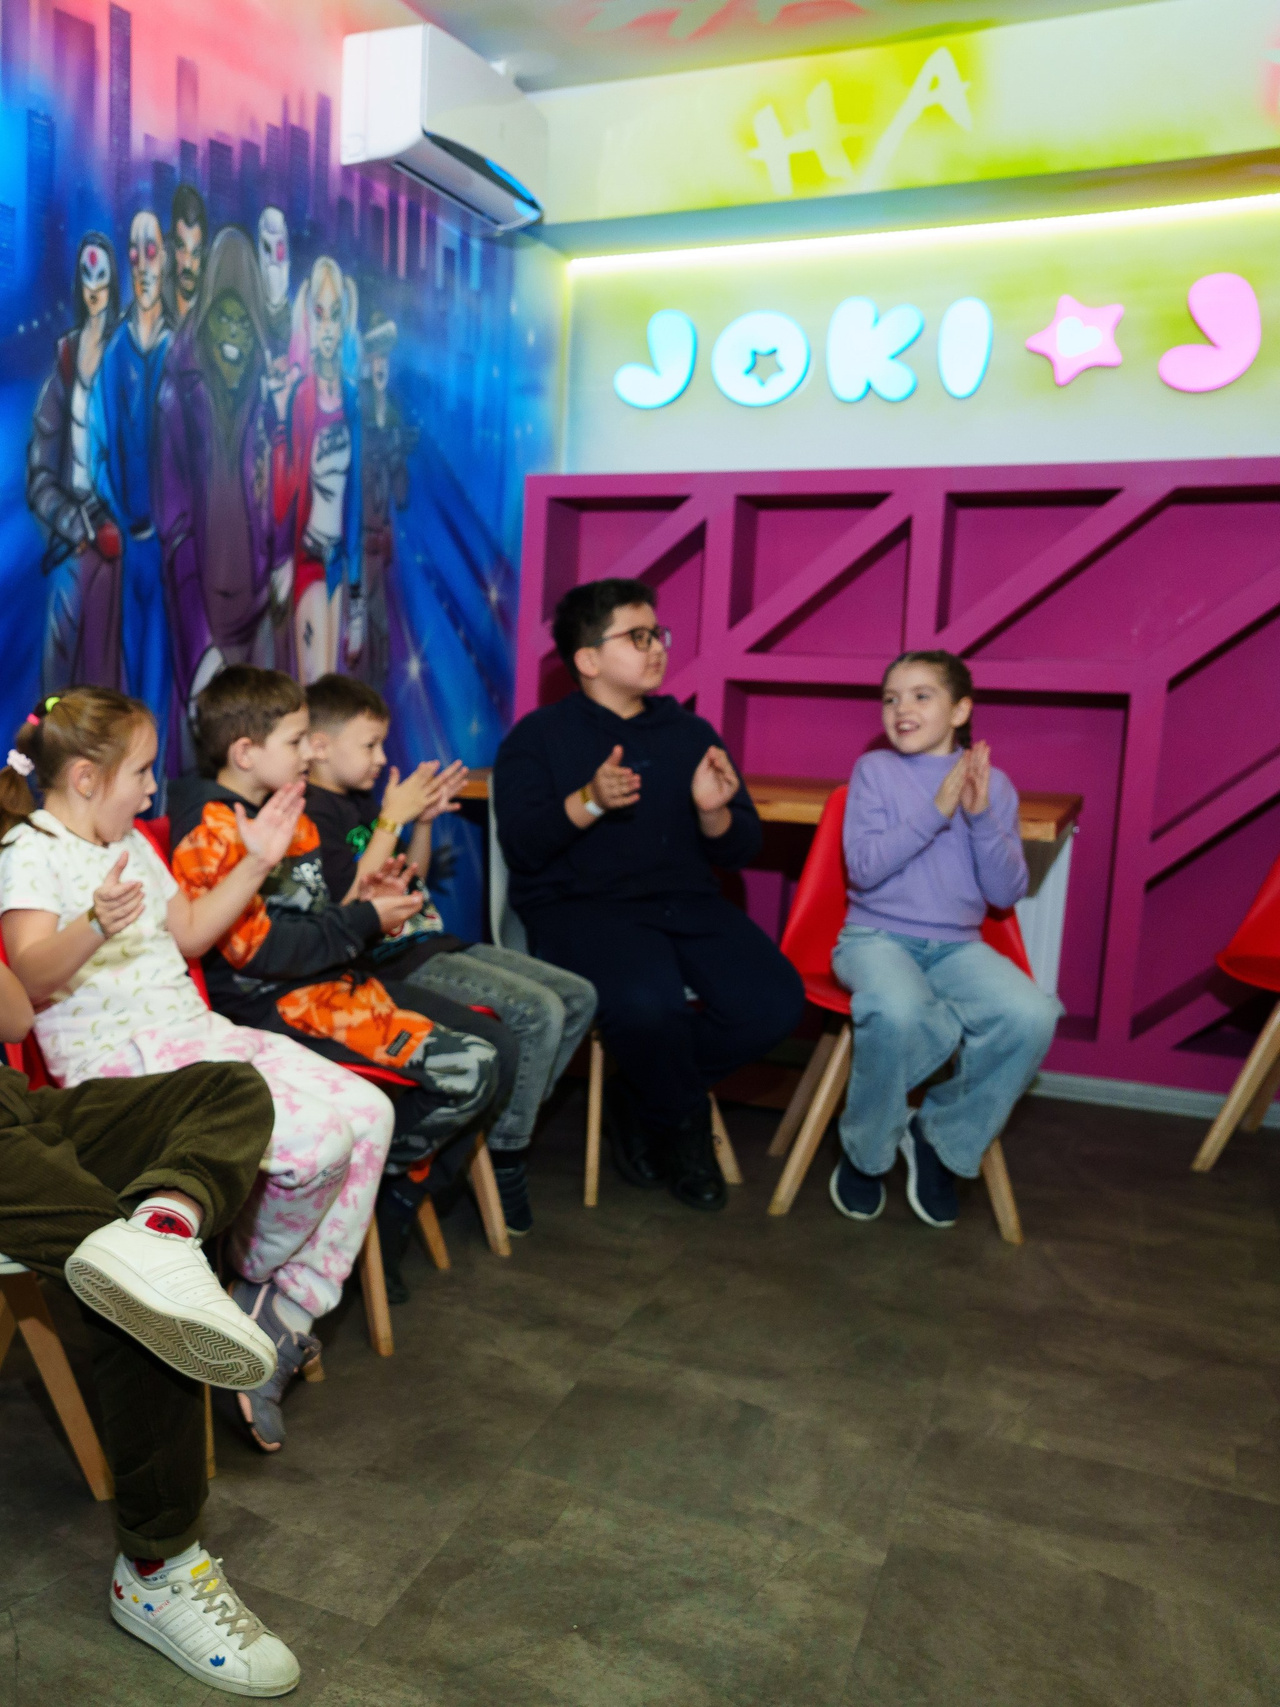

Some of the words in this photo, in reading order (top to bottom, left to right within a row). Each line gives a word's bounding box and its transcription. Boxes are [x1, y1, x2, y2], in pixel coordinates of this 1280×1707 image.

[746, 46, 974, 196] HA
[613, 295, 994, 411] JOKI
[1157, 271, 1263, 394] J
